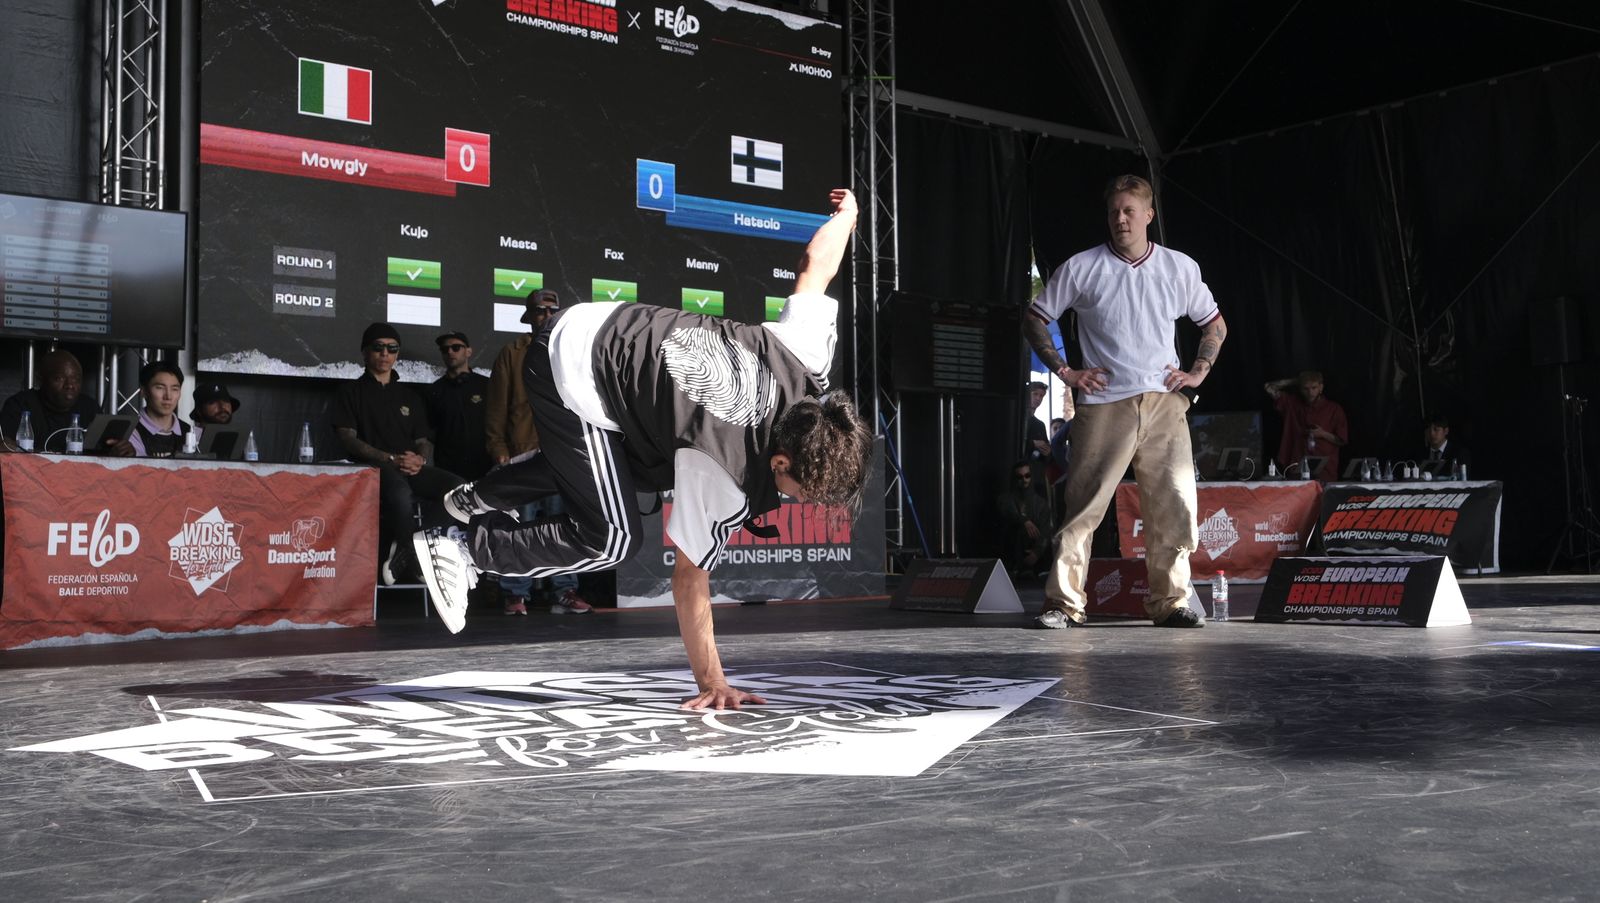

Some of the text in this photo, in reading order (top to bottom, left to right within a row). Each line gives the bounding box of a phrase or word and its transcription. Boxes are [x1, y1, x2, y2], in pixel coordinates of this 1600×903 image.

[506, 12, 619, 44] CHAMPIONSHIPS SPAIN
[811, 46, 832, 59] B-boy
[301, 151, 368, 176] Mowgly
[459, 144, 475, 172] 0
[649, 173, 663, 199] 0
[276, 254, 334, 270] ROUND 1
[604, 248, 624, 261] Fox
[686, 257, 719, 273] Manny
[773, 268, 796, 280] Skim
[275, 292, 334, 308] ROUND 2
[1336, 502, 1369, 510] WDSF
[1367, 493, 1470, 509] EUROPEAN
[1204, 516, 1233, 531] WDSF
[1323, 509, 1459, 536] BREAKING
[183, 522, 234, 546] WDSF
[269, 531, 290, 545] world
[1254, 532, 1299, 543] DanceSport
[1323, 530, 1449, 547] HAMPIONSHIPS SPAIN
[170, 546, 241, 560] BREAKING
[267, 547, 336, 566] DanceSport
[663, 548, 851, 566] CPIONSHIPS SPAIN
[48, 572, 138, 584] FEDERACIÓN ESPAÑOLA
[1320, 567, 1411, 582] EUROPEAN
[59, 586, 129, 596] BAILE DEPORTIVO
[1286, 583, 1405, 606] BREAKING
[1283, 605, 1399, 615] CHAMPIONSHIPS SPAIN
[496, 730, 662, 768] for
